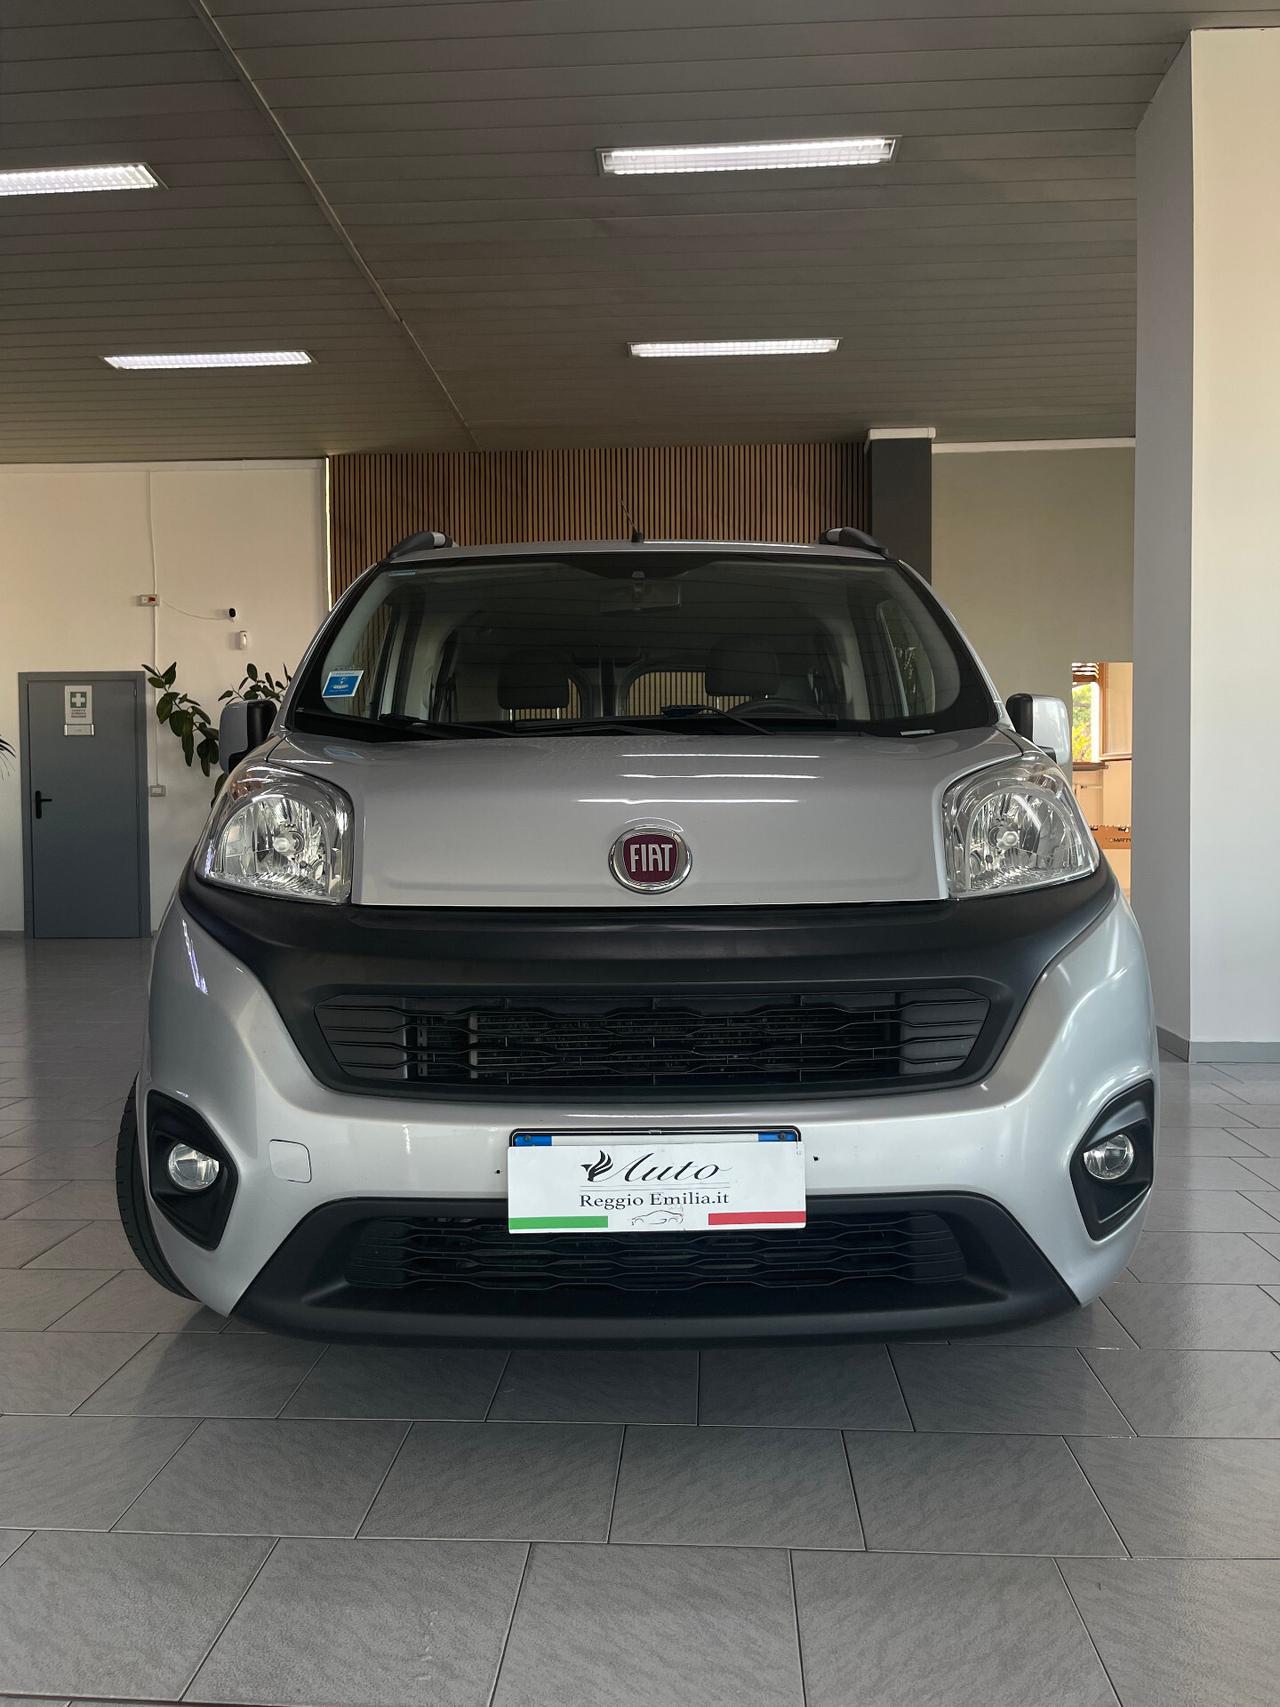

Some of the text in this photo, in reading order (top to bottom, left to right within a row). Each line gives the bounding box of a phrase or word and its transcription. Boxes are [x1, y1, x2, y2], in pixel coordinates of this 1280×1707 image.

[630, 844, 673, 872] FIAT
[589, 1152, 732, 1182] Auto
[579, 1191, 729, 1210] Reggio Emilia.it
